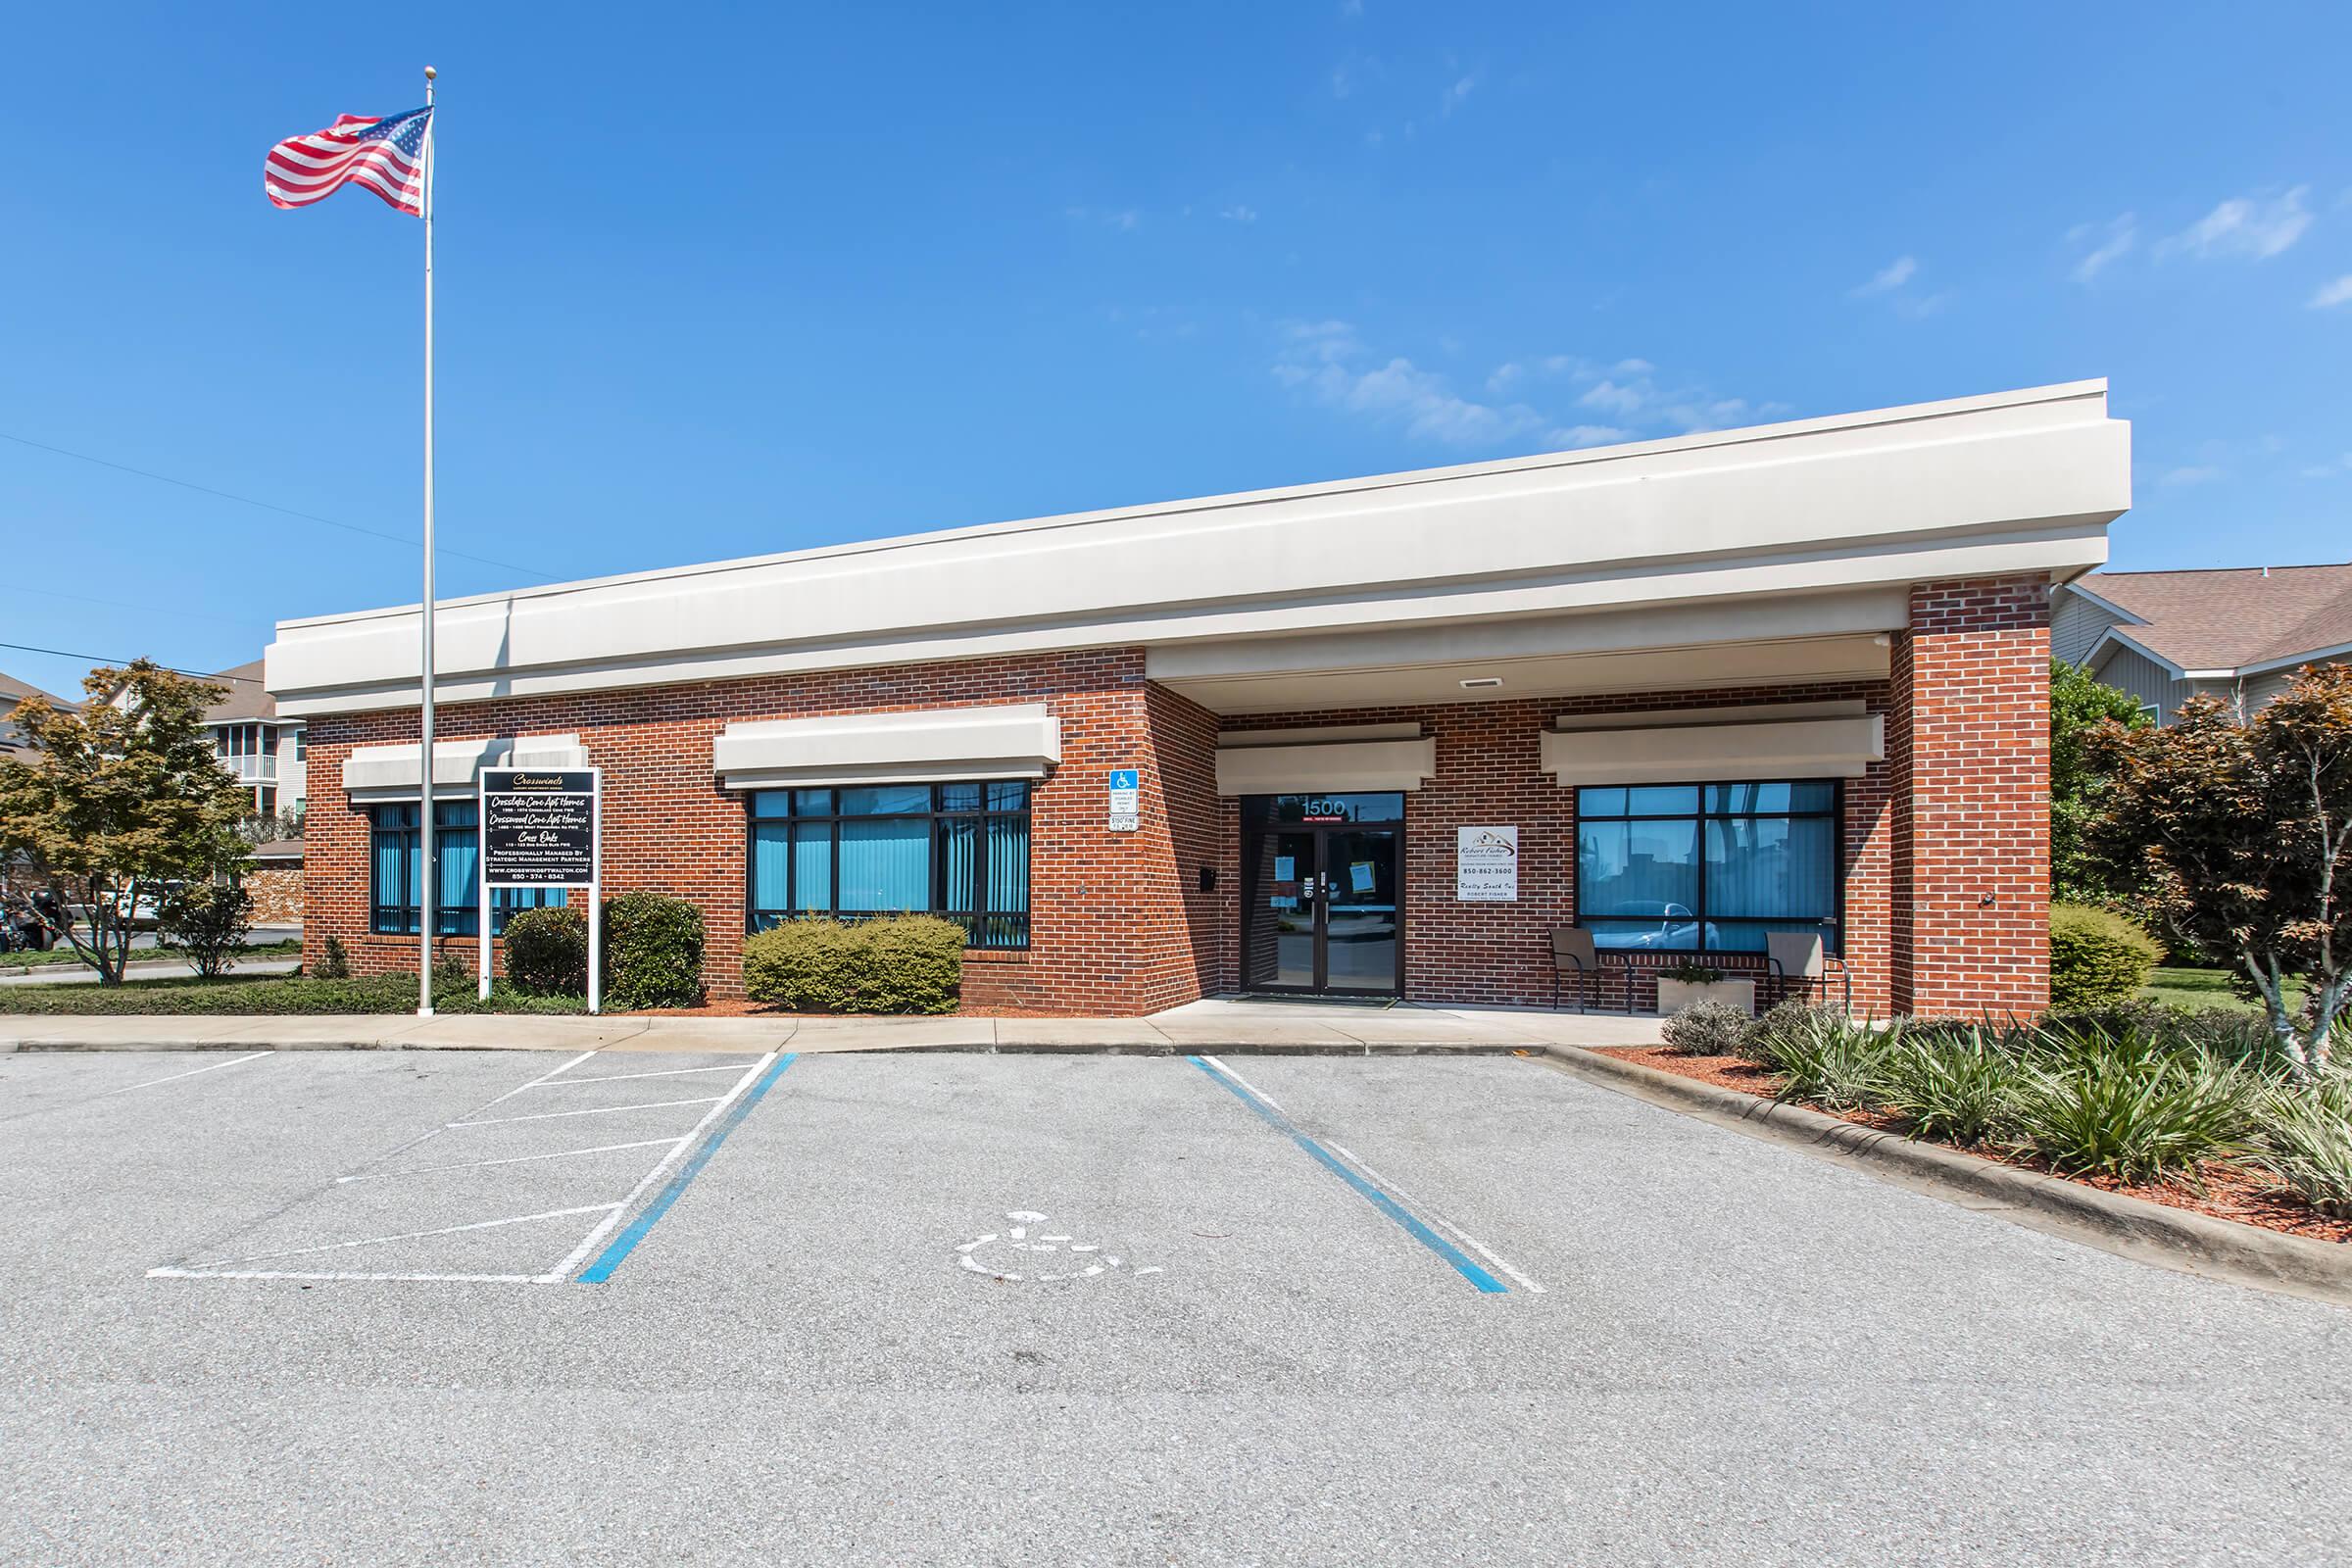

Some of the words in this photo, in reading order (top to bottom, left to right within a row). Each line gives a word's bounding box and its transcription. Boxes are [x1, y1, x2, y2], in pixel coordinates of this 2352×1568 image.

[513, 773, 564, 785] Crosswinds
[491, 796, 526, 808] Crosslake
[526, 796, 544, 808] Cove
[544, 796, 561, 809] Apt
[560, 795, 585, 806] Homes
[1301, 801, 1345, 815] 1500
[489, 813, 528, 825] Crosswood
[528, 813, 547, 825] Cove
[546, 813, 562, 827] Apt
[562, 813, 587, 823] Homes
[517, 831, 537, 842] Cross
[539, 831, 558, 844] Oaks
